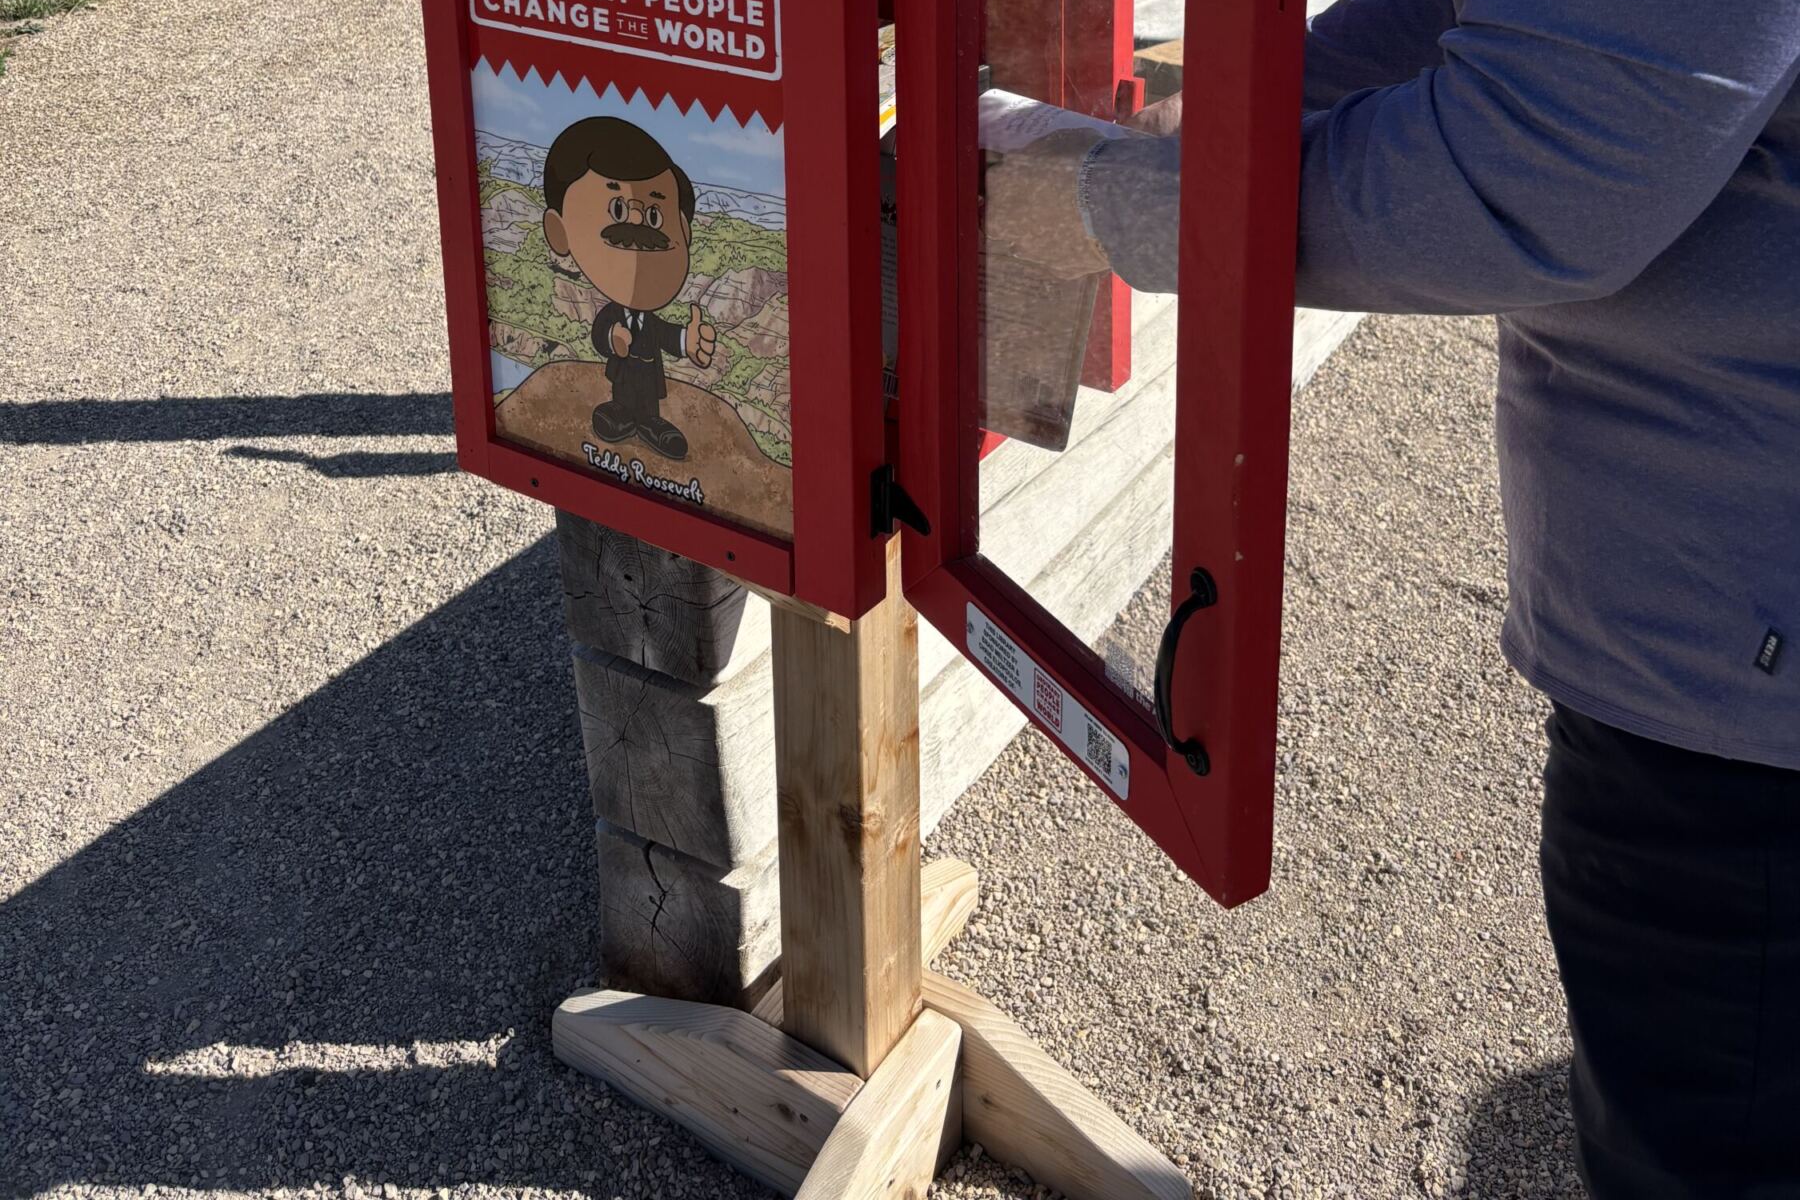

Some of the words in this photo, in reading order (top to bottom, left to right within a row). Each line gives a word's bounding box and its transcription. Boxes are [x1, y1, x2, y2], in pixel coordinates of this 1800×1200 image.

[616, 17, 649, 35] THE
[654, 17, 766, 61] WORLD
[582, 442, 629, 483] Teddy
[630, 459, 704, 504] Roosevelt
